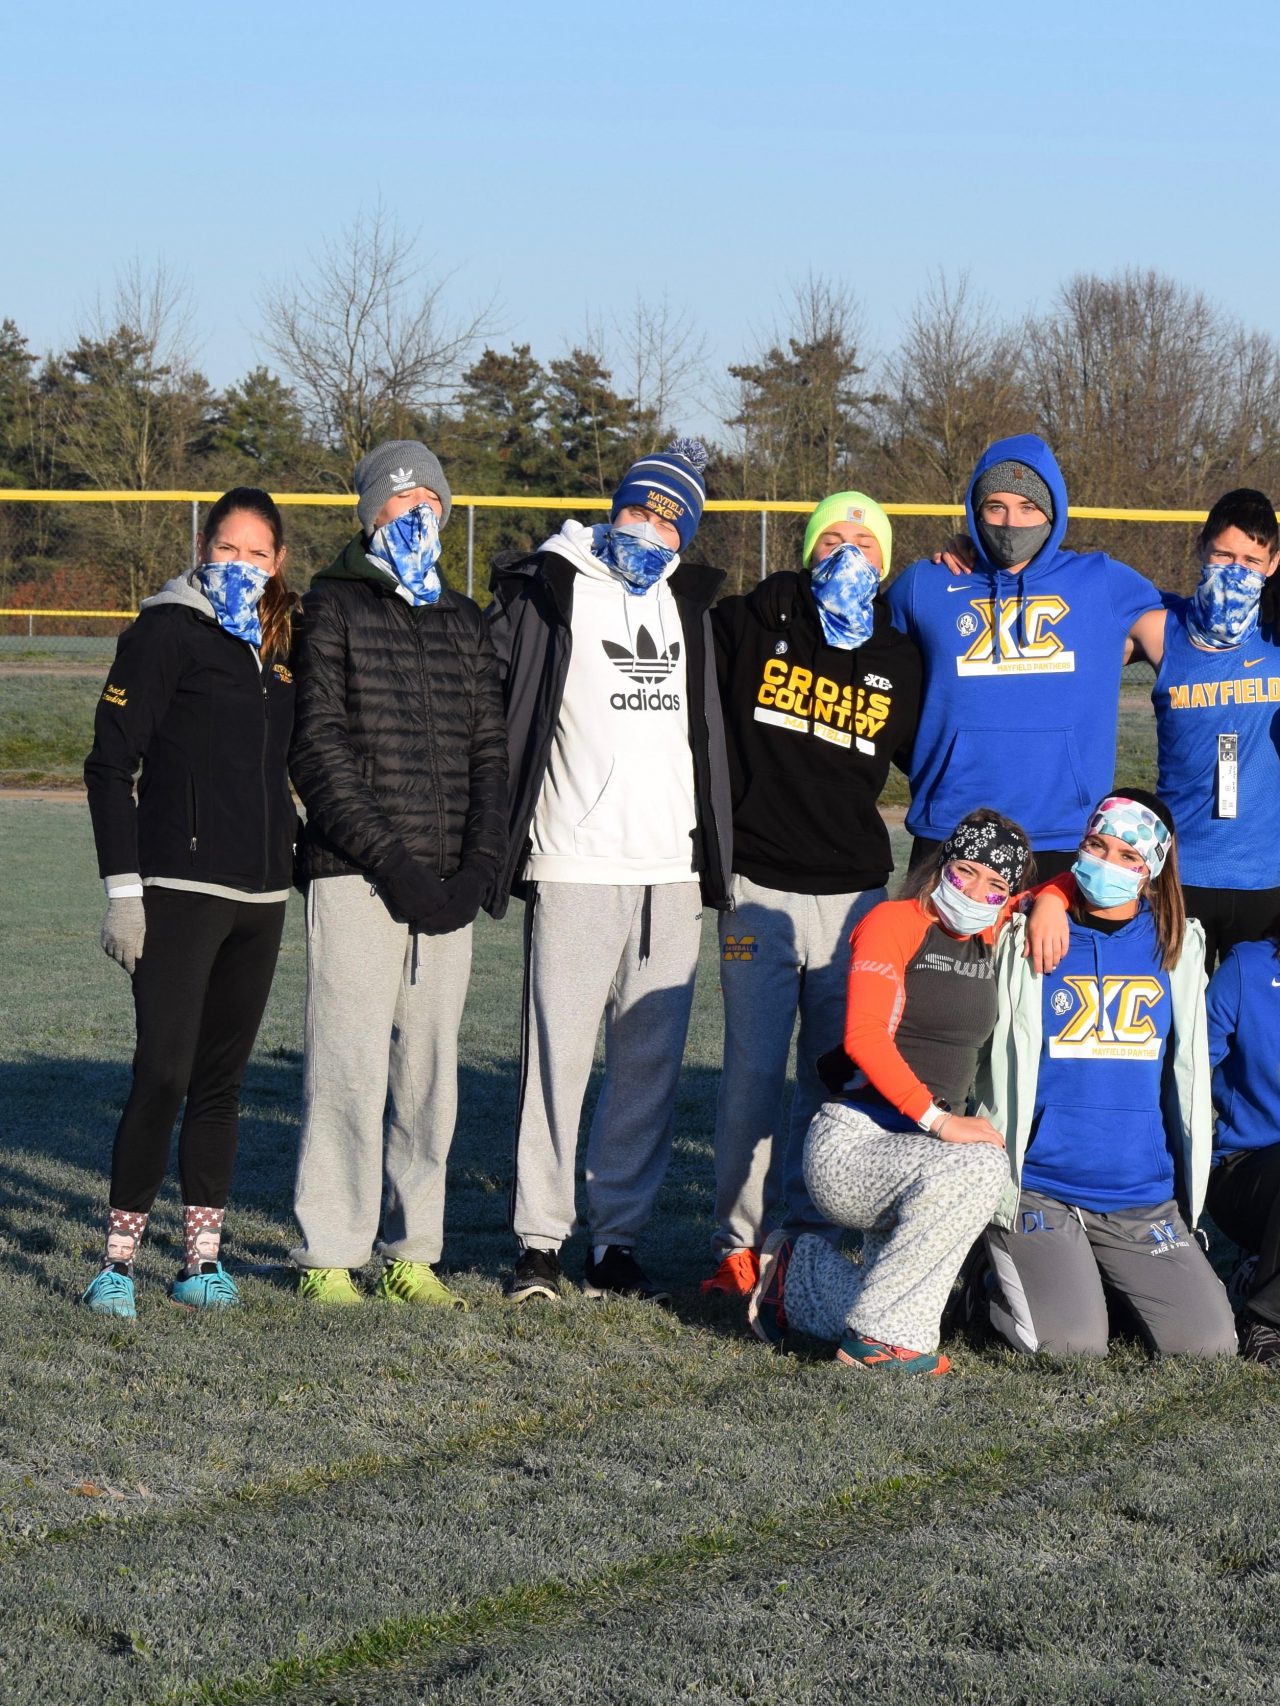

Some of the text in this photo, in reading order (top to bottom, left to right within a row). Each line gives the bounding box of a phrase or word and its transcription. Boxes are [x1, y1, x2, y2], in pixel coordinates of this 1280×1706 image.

[647, 490, 685, 516] MAYFIELD
[962, 595, 1071, 664] XC
[609, 688, 681, 711] adidas
[757, 683, 886, 737] COUNTRY
[763, 658, 892, 720] CROSS
[783, 715, 850, 745] MAFIELD
[1055, 975, 1165, 1047] XC
[1021, 1210, 1055, 1235] DL
